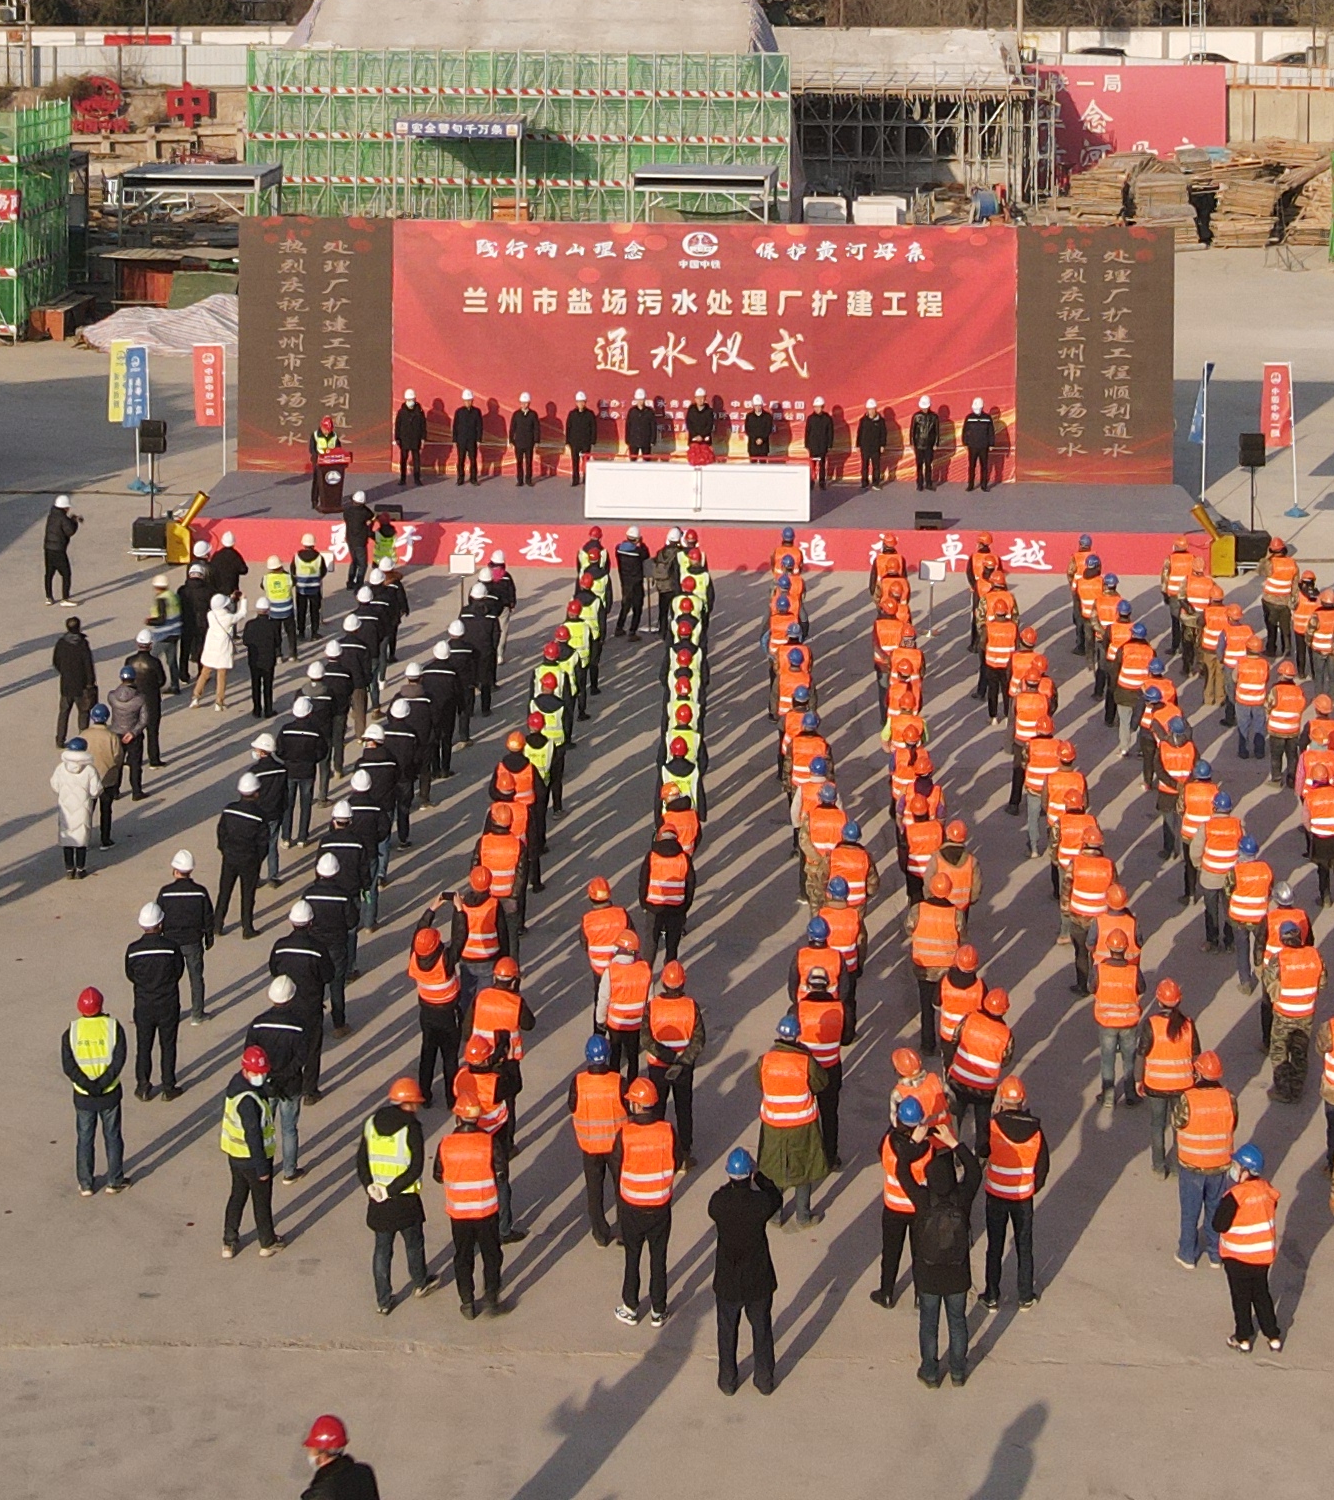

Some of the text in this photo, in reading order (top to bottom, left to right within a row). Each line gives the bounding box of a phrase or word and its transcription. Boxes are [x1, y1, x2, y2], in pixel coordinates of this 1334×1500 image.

[411, 122, 503, 135] 安全警句千万条
[321, 240, 354, 444] 处理厂扩建工程顺利通
[463, 287, 944, 318] 兰州市盐场污水处理厂扩建工程
[594, 327, 810, 379] 通水仪式
[1056, 248, 1091, 457] 热烈庆祝兰州市盐场污水
[1100, 249, 1136, 458] 处理厂扩建工程顺利通水
